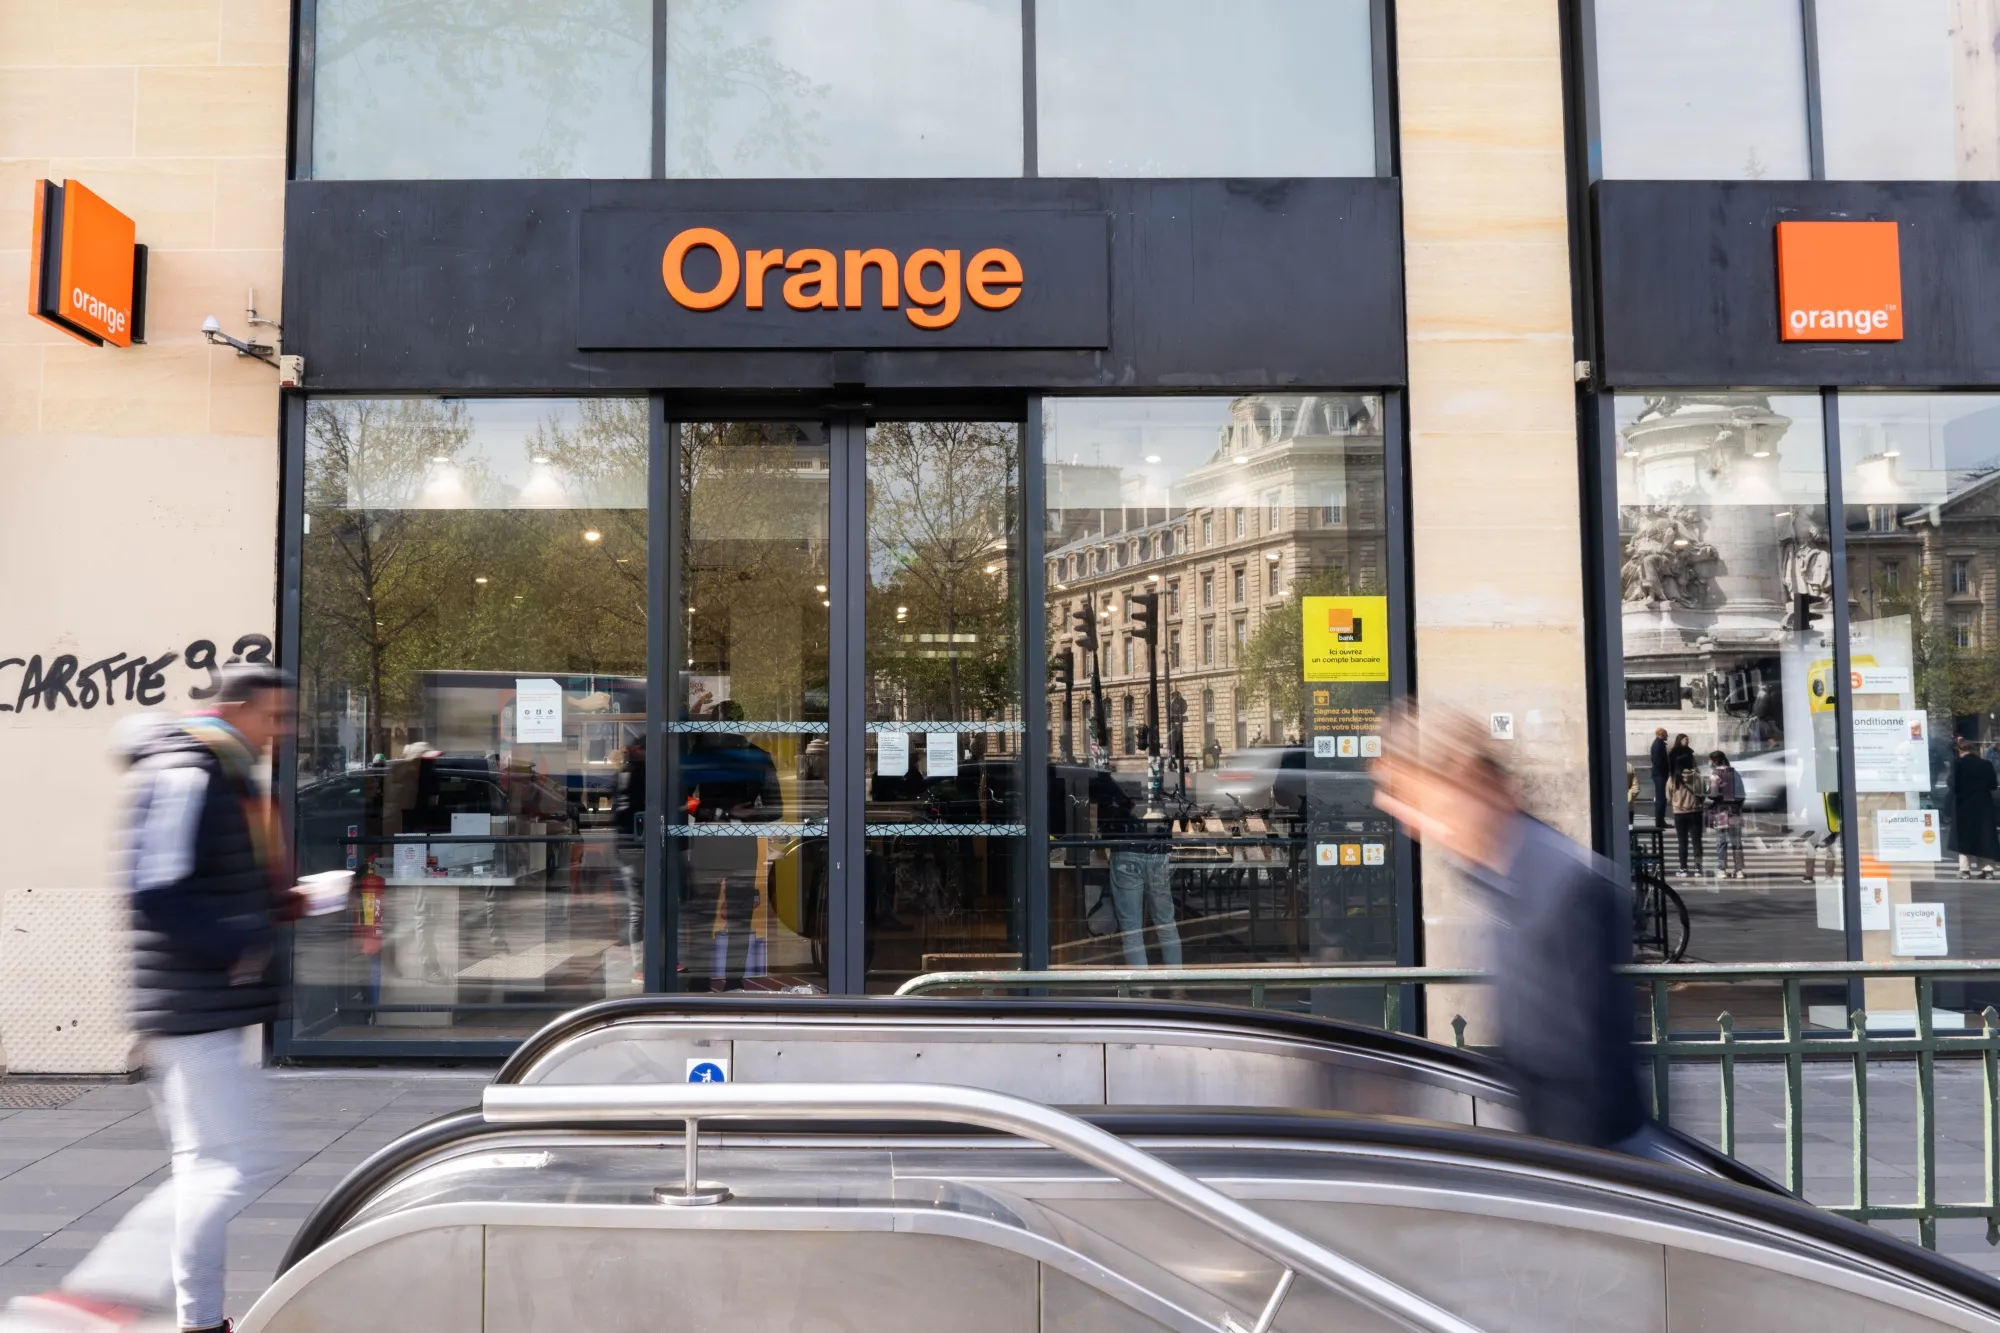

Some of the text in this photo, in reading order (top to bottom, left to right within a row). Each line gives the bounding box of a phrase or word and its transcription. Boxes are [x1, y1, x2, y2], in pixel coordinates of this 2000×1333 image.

[662, 227, 1024, 330] Orange
[73, 287, 126, 334] orange
[1790, 309, 1889, 335] orange
[1854, 716, 1904, 726] onditionné
